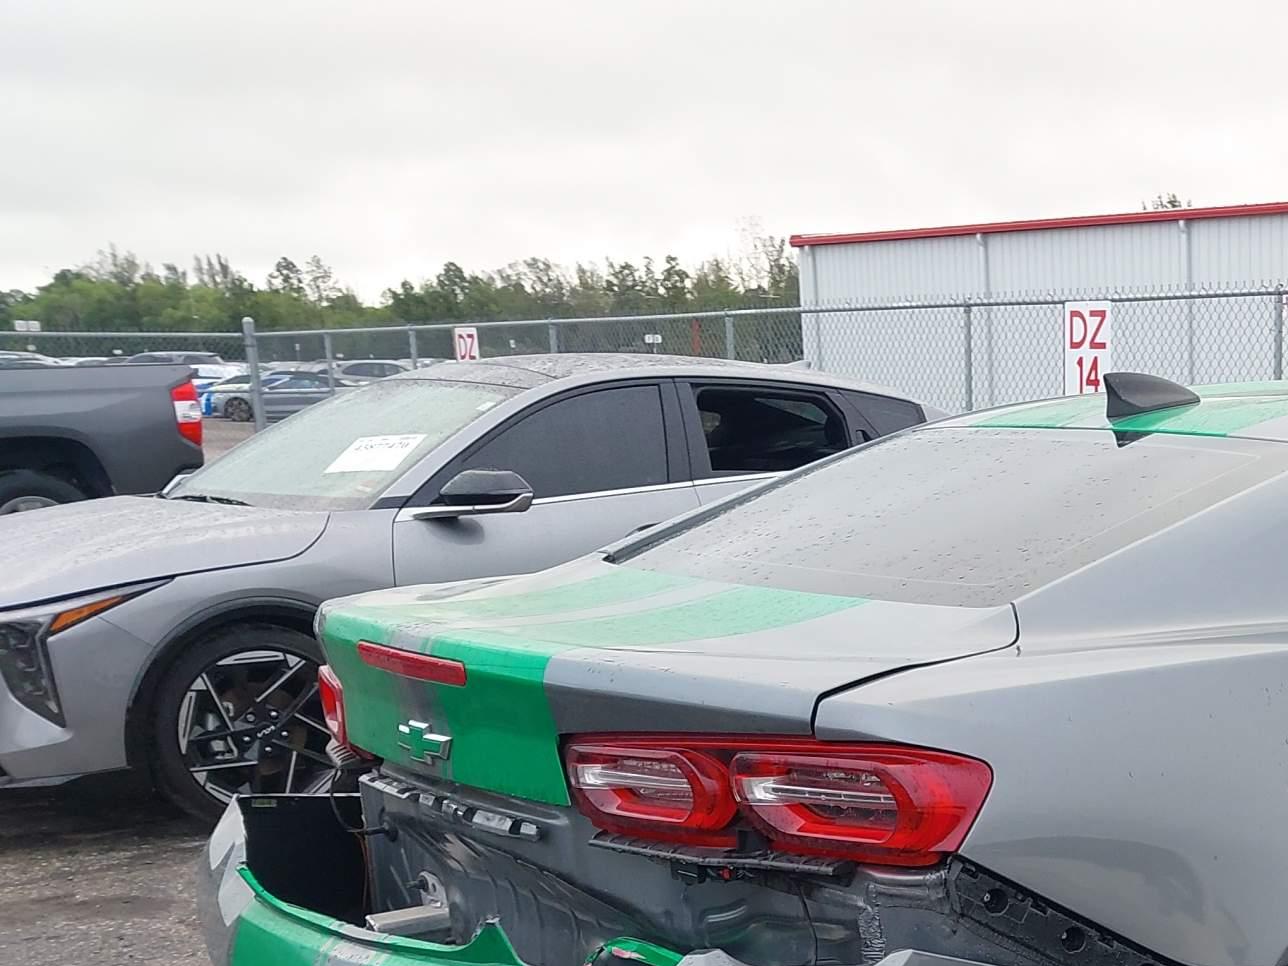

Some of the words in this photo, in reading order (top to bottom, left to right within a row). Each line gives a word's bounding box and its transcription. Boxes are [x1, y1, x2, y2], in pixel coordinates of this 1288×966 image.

[458, 334, 476, 360] DZ
[1070, 310, 1107, 350] DZ
[1076, 356, 1100, 394] 14
